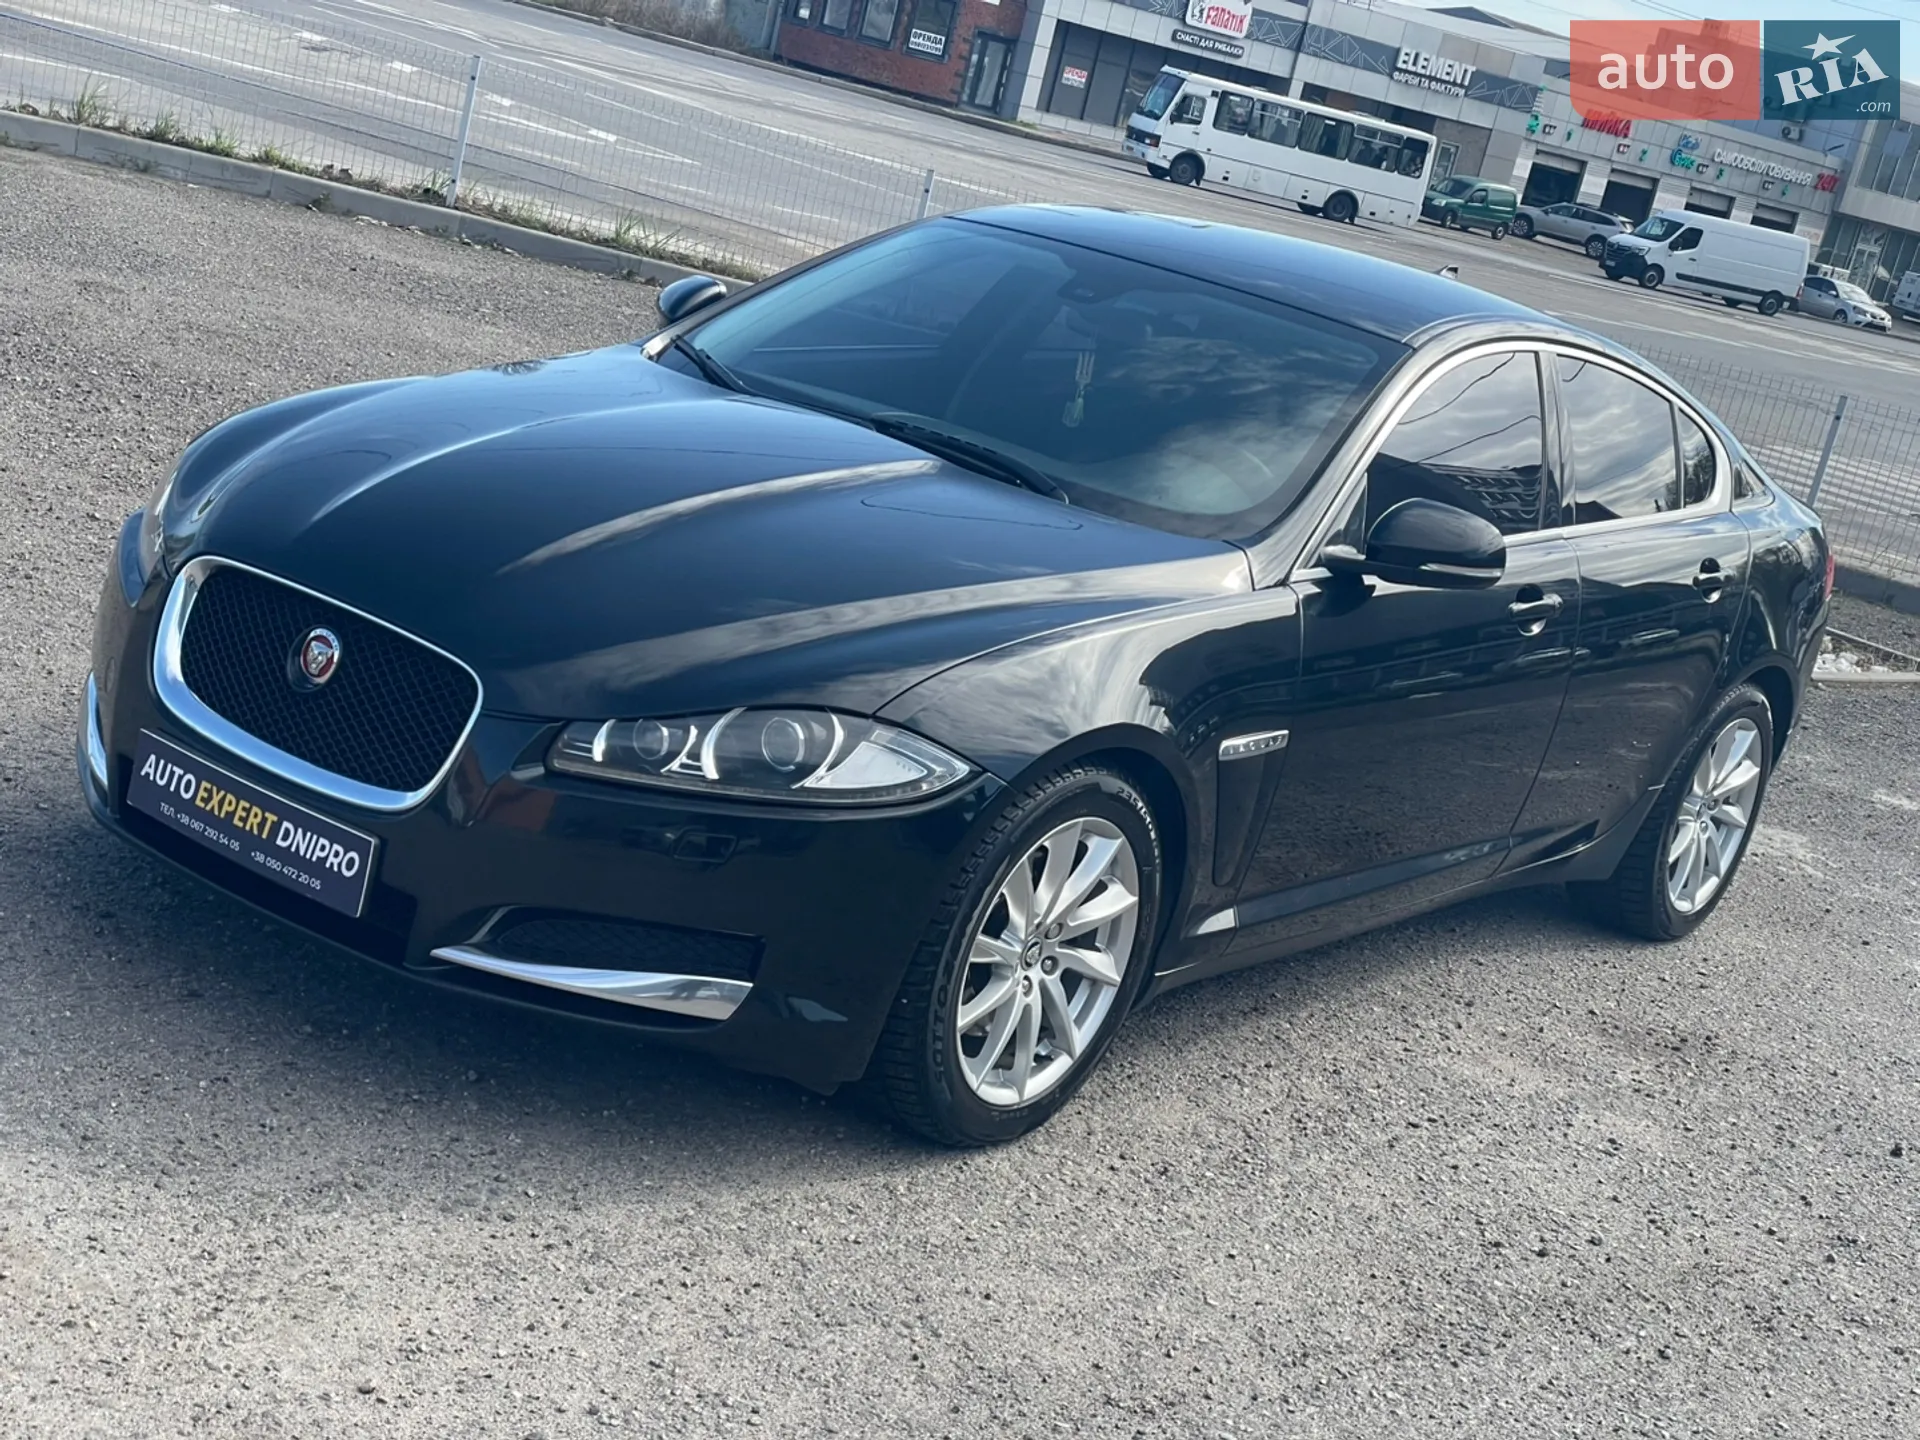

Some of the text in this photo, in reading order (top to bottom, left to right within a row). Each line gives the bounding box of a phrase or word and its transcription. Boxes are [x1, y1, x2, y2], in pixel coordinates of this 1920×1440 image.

[1392, 70, 1467, 98] ФАРБИ ТА ФАКТУРИ
[1396, 46, 1477, 87] ELEMENT
[140, 753, 360, 878] AUTO EXPERT DNIPRO
[177, 812, 190, 826] +38
[190, 818, 205, 833] 067
[204, 826, 219, 841] 292
[218, 833, 229, 846] 54
[229, 839, 241, 852] 05
[250, 850, 322, 891] +38 050 472 20 05
